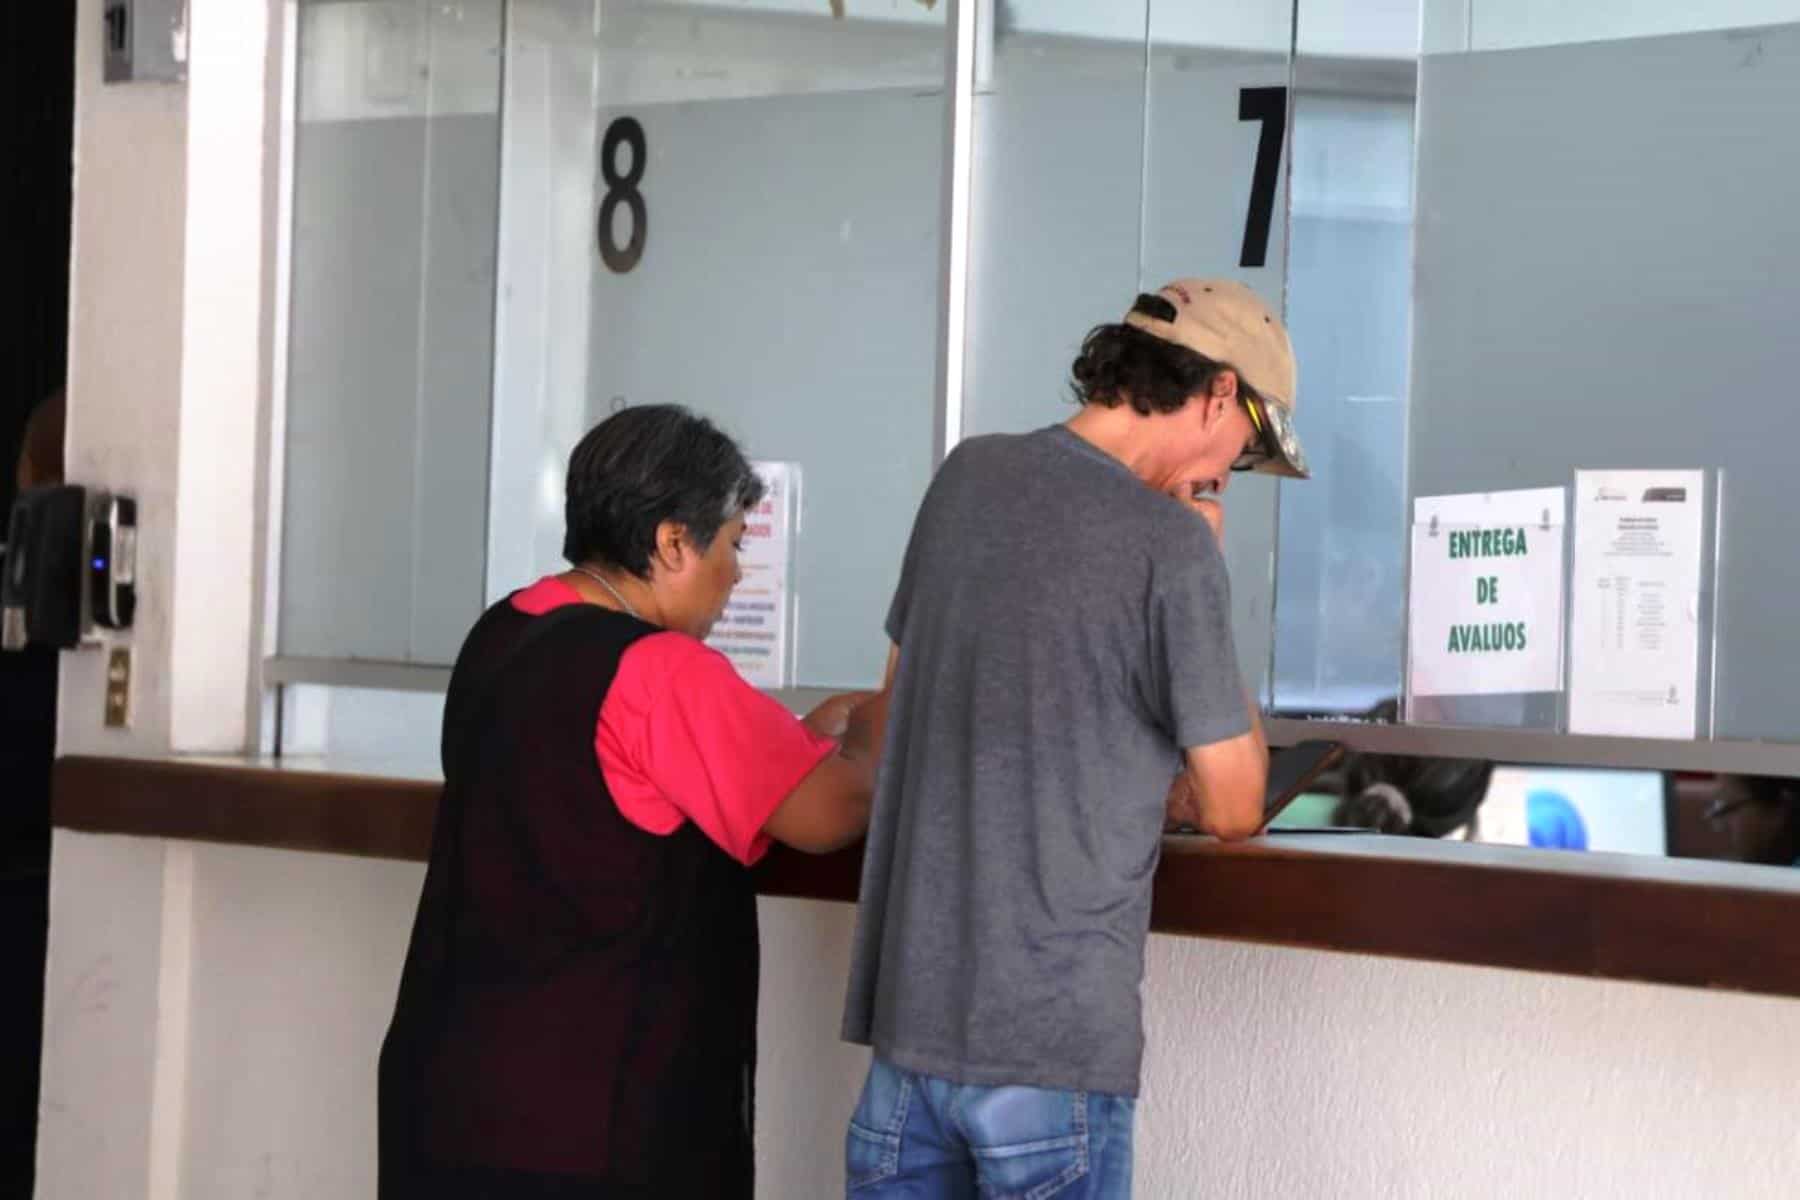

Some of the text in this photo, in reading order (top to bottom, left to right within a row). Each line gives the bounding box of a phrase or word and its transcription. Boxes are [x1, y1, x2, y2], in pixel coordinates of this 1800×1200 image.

[1239, 87, 1287, 267] 7
[598, 116, 648, 274] 8
[1448, 527, 1528, 560] ENTREGA
[1476, 576, 1500, 605] DE
[1448, 621, 1527, 654] AVALUOS
